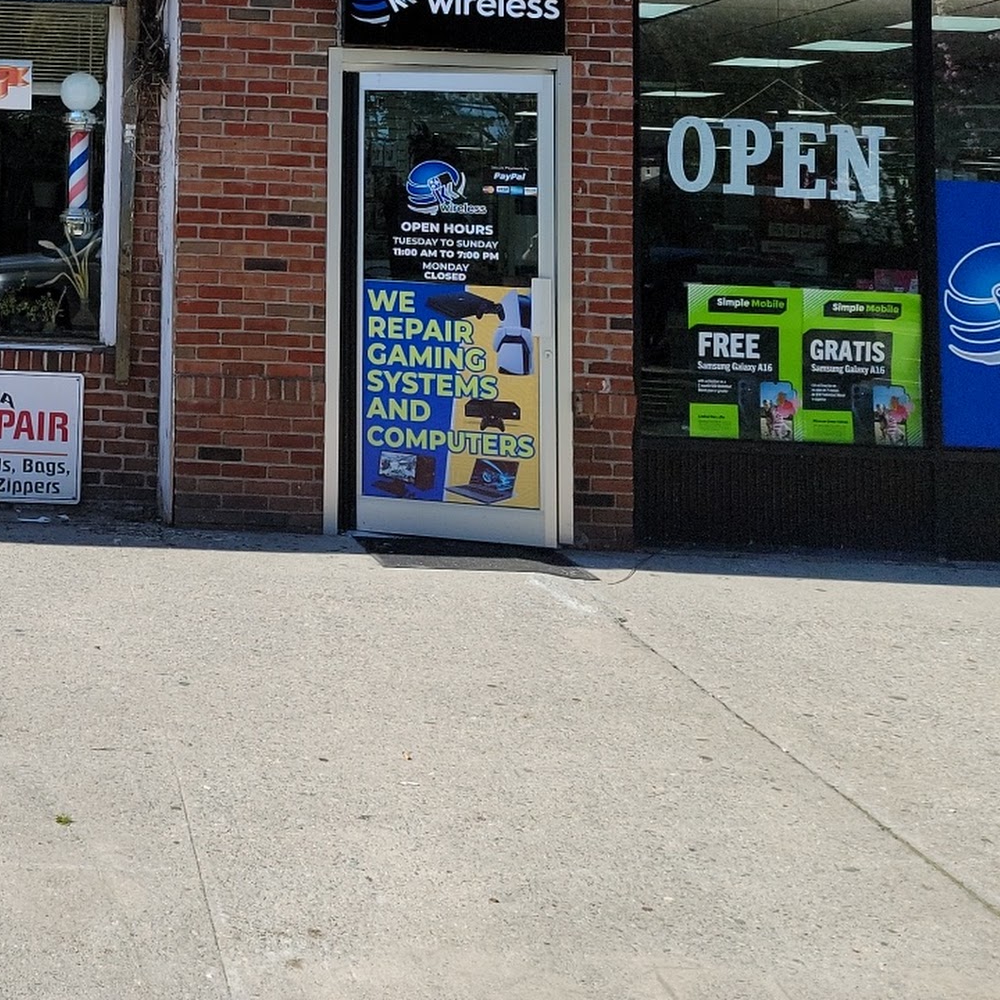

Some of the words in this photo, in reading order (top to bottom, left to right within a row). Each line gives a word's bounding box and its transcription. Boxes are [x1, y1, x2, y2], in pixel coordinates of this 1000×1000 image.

[667, 116, 886, 202] OPEN
[494, 172, 526, 181] PayPal
[401, 221, 440, 233] OPEN
[444, 223, 493, 235] HOURS
[392, 236, 438, 246] TUESDAY
[440, 239, 454, 247] TO
[456, 240, 499, 249] SUNDAY
[393, 248, 418, 256] 11:00
[420, 249, 437, 257] AM
[439, 250, 454, 258] TO
[457, 251, 480, 259] 7:00
[483, 252, 499, 260] PM
[422, 262, 470, 272] MONDAY
[424, 272, 466, 281] CLOSED
[367, 289, 415, 313] WE
[717, 297, 750, 308] Simple
[751, 299, 784, 309] Mobile
[832, 303, 865, 313] Simple
[865, 304, 899, 314] Mobile
[368, 316, 474, 344] REPAIR
[698, 332, 760, 359] FREE
[810, 339, 885, 363] GRATIS
[367, 343, 486, 372] GAMING
[697, 361, 731, 372] Samsung
[732, 363, 757, 373] Galaxy
[757, 363, 773, 372] A16
[811, 364, 844, 374] Samsung
[845, 365, 869, 375] Galaxy
[870, 366, 885, 375] A16
[367, 369, 498, 399] SYSTEMS
[366, 397, 431, 422] AND
[367, 426, 535, 458] COMPUTERS
[22, 458, 70, 476] Bags,
